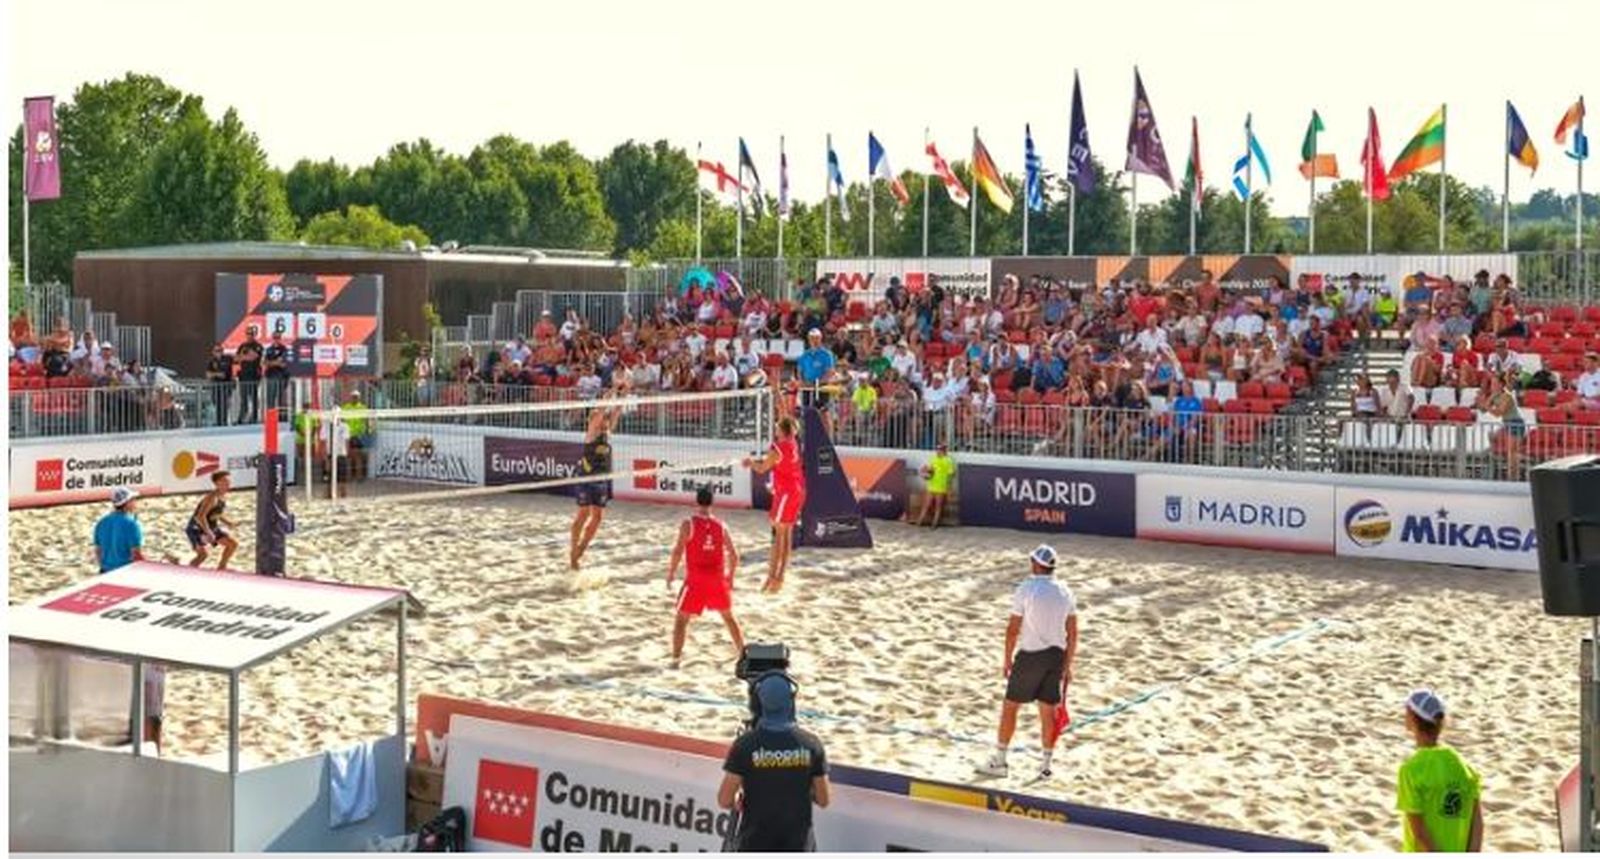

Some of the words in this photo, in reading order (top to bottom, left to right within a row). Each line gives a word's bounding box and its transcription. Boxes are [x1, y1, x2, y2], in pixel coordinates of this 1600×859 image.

[275, 316, 286, 334] 6
[306, 318, 317, 334] 6
[66, 454, 144, 471] Comunidad
[65, 475, 85, 490] de
[91, 471, 143, 487] Madrid
[995, 477, 1096, 506] MADRID
[1024, 508, 1066, 524] SPAIN
[1198, 500, 1307, 529] MADRID
[141, 590, 331, 624] Comunidad
[99, 606, 150, 622] de
[149, 611, 294, 641] Madrid
